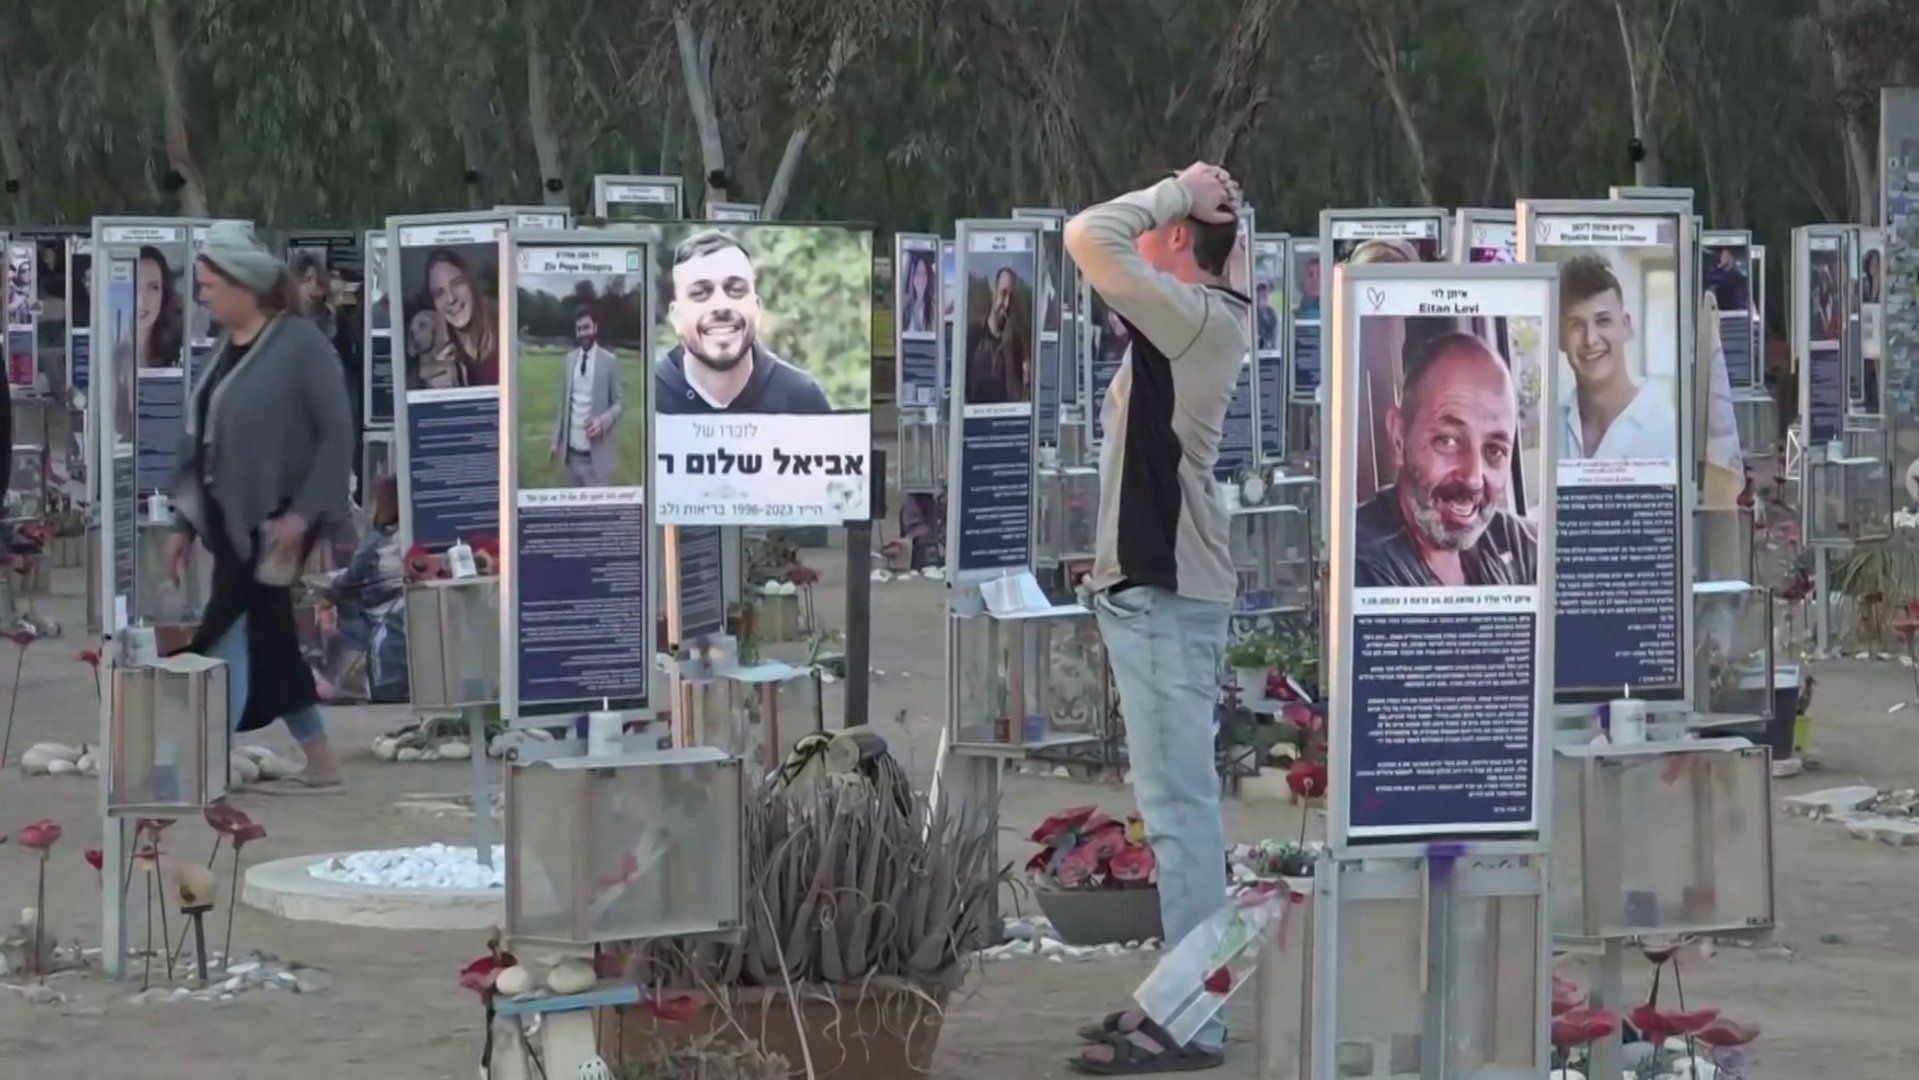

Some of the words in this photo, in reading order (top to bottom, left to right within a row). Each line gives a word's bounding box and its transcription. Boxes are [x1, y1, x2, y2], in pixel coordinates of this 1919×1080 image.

[1419, 302, 1450, 314] Eitan
[1454, 302, 1480, 314] Levi
[693, 422, 715, 439] של
[720, 422, 758, 438] לזכרו
[685, 447, 763, 476] שלום
[772, 447, 864, 476] אביאל
[683, 503, 726, 517] בריאות
